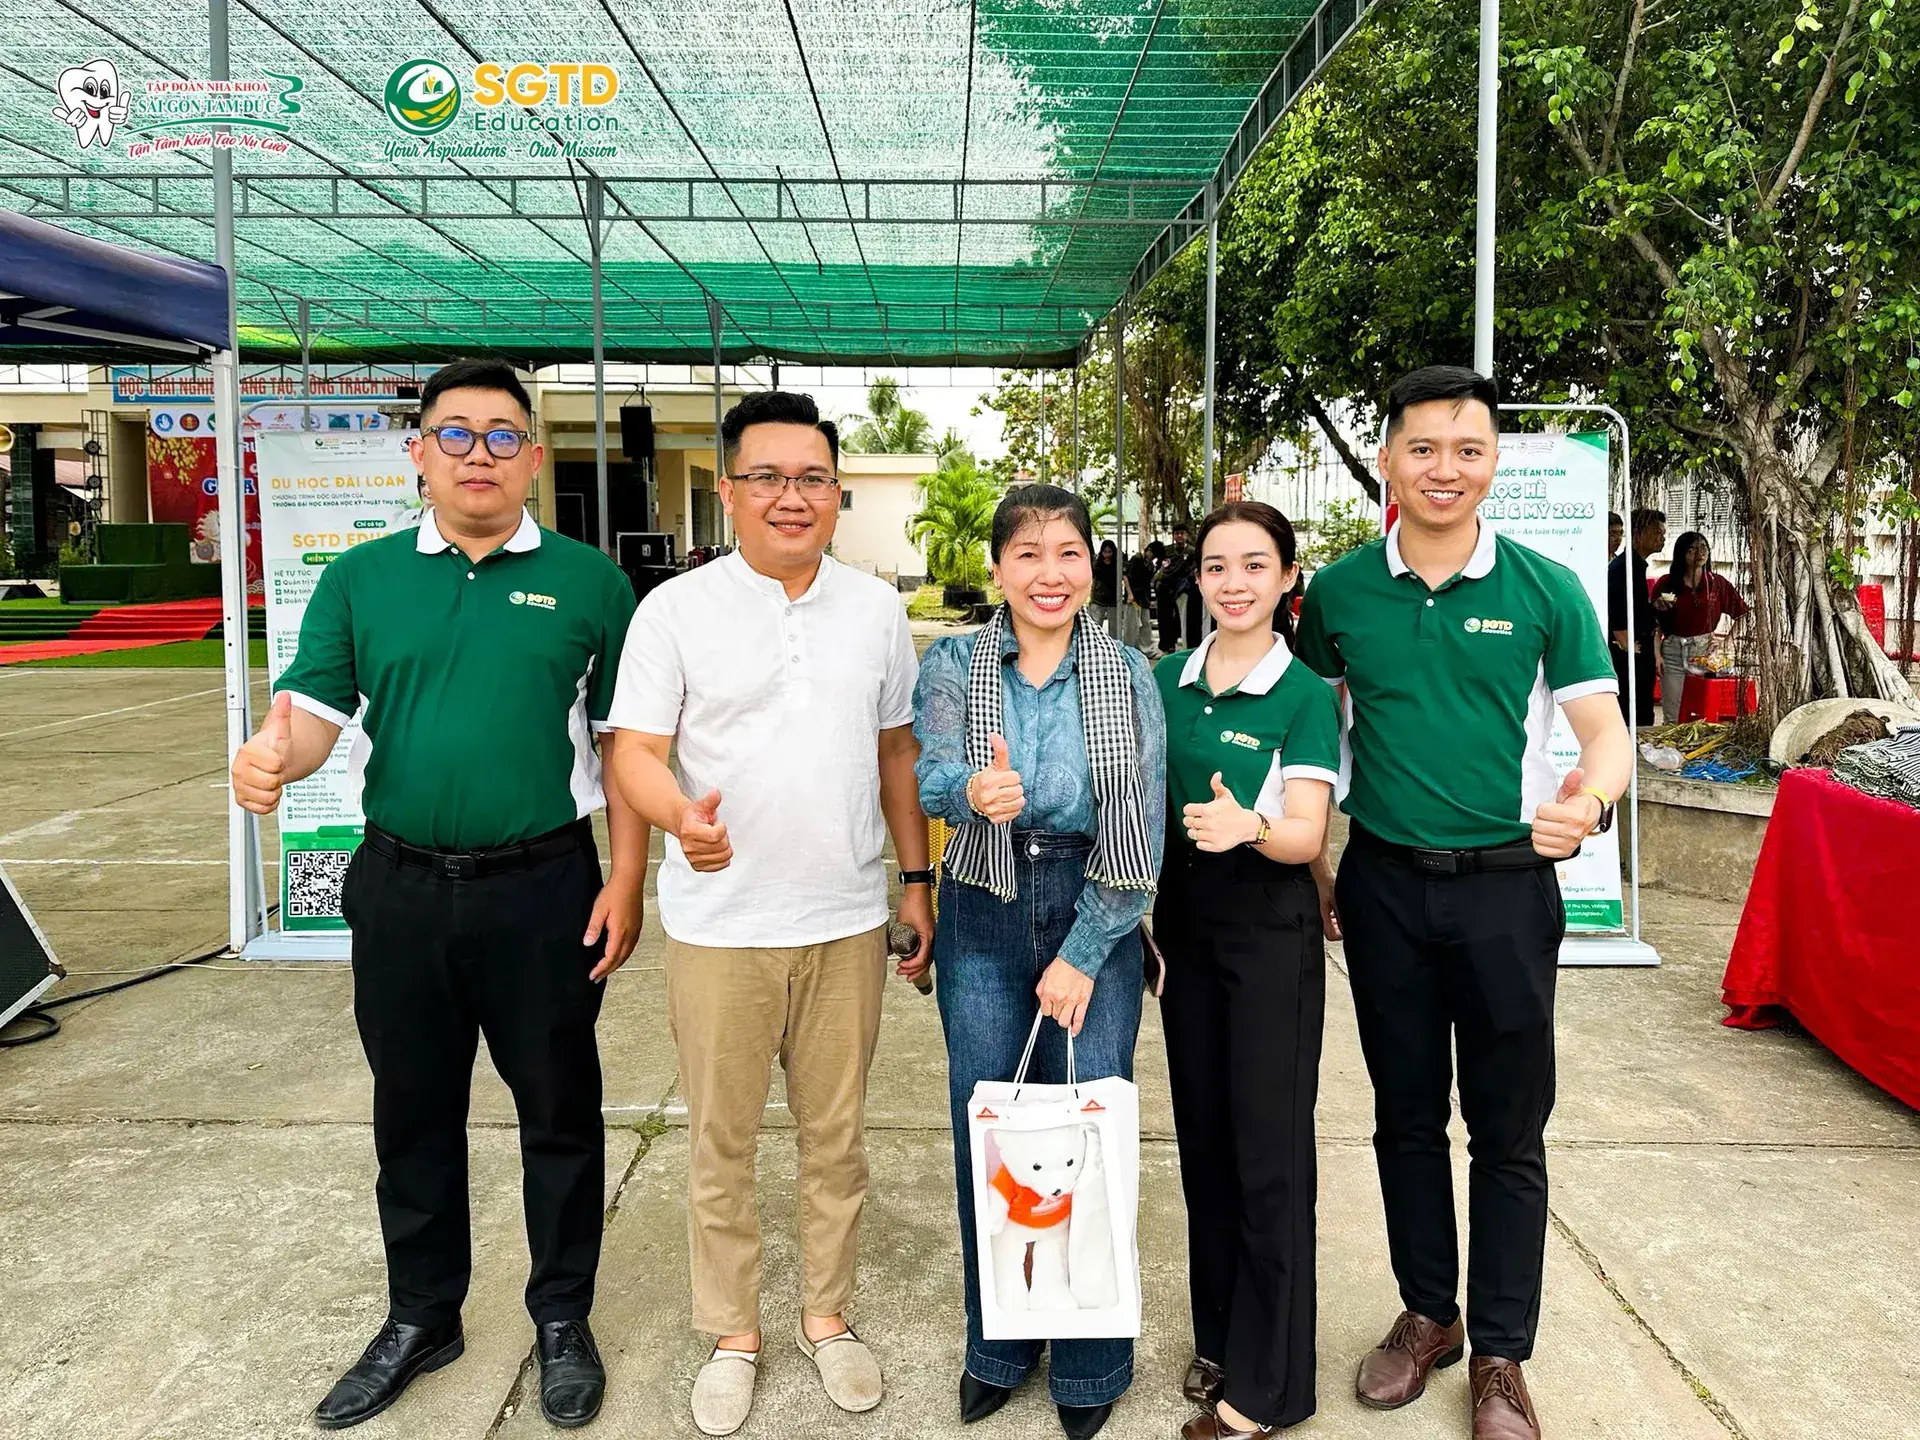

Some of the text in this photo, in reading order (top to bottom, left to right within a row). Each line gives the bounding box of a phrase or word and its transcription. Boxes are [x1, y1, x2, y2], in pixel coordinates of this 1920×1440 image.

[118, 376, 144, 400] HỌC
[179, 376, 214, 399] NGHI
[241, 373, 266, 395] ÁNG
[339, 373, 378, 395] TRÁCH
[1519, 466, 1529, 477] TẾ
[1529, 469, 1542, 477] AN
[1543, 466, 1567, 477] TOÀN
[271, 474, 406, 492] DU HỌC ĐÀI LOAN
[1524, 479, 1547, 499] HÈ
[1507, 502, 1521, 520] &
[1553, 502, 1596, 520] 2026
[292, 532, 341, 548] SGTD
[1482, 619, 1513, 631] SGTD
